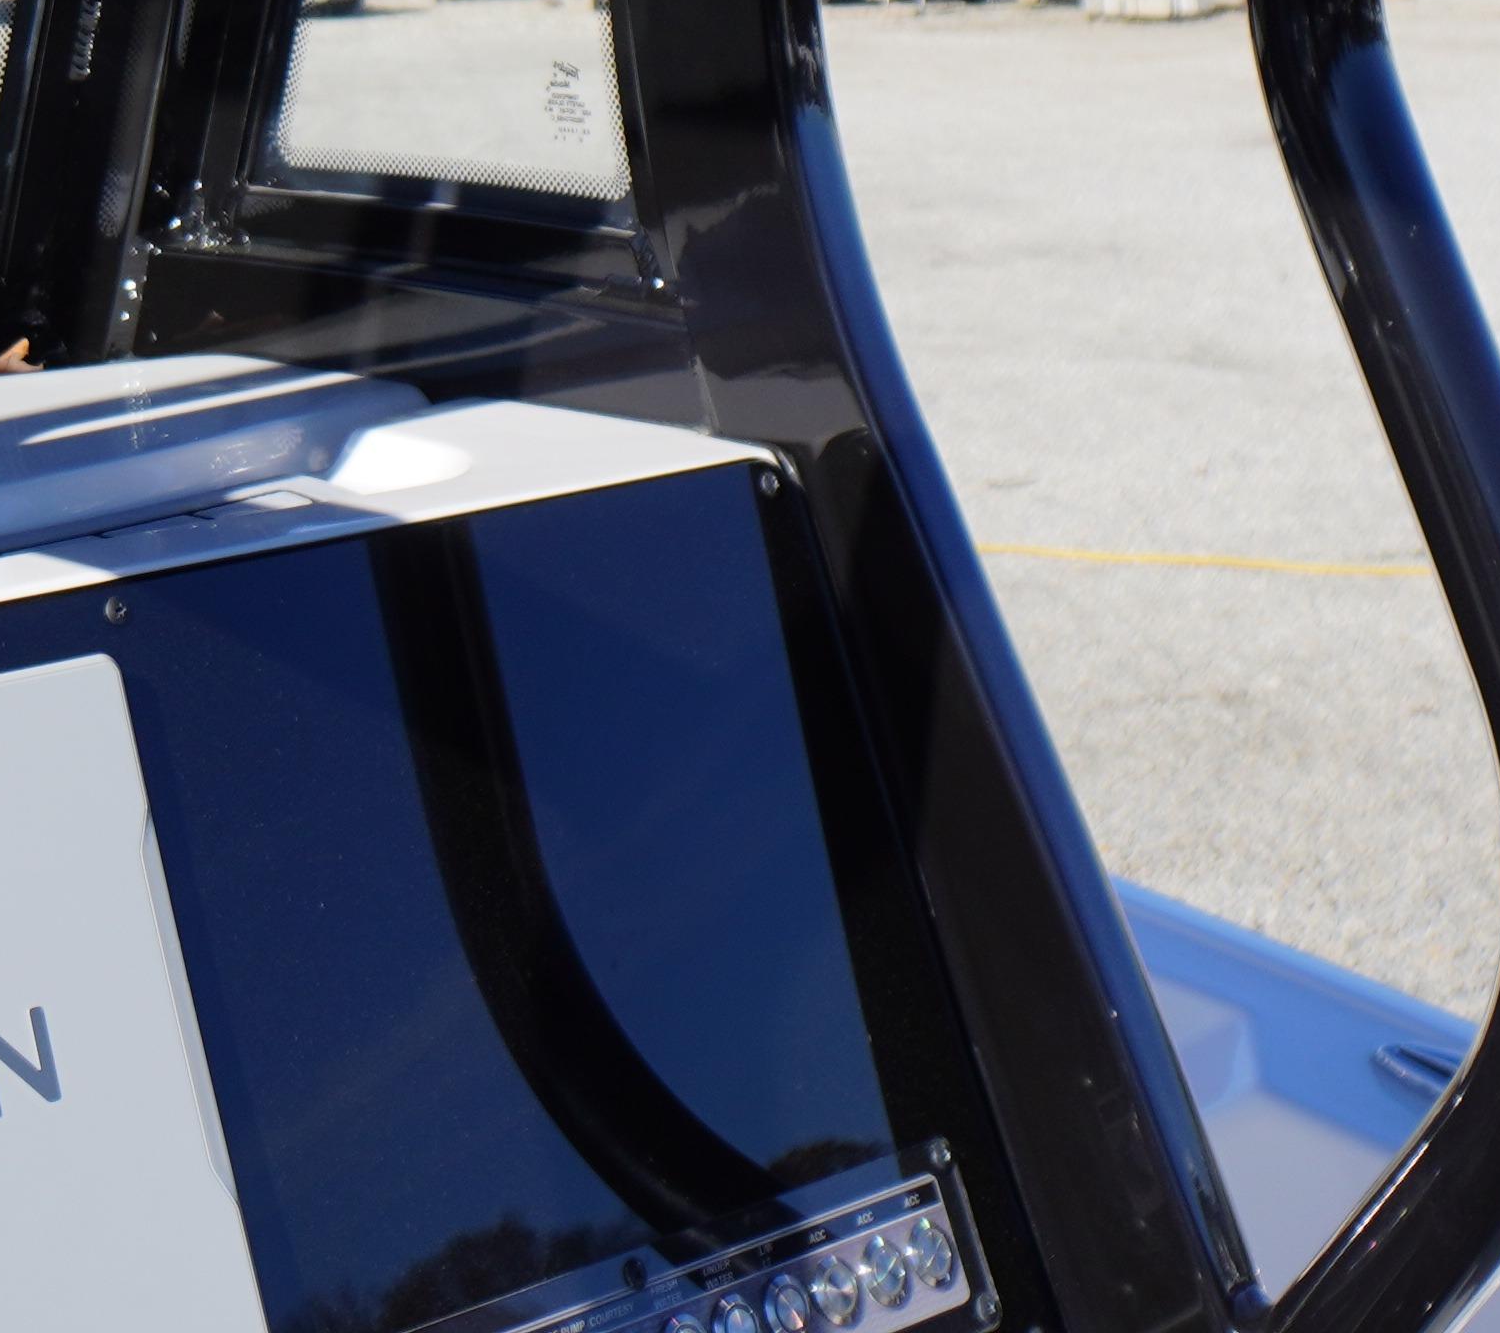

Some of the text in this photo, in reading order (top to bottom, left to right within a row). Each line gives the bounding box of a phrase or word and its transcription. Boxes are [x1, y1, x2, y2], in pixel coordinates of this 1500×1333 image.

[904, 1192, 921, 1209] ACC
[856, 1210, 874, 1226] ACC
[808, 1228, 828, 1245] ACC
[588, 1301, 634, 1327] COURTESY
